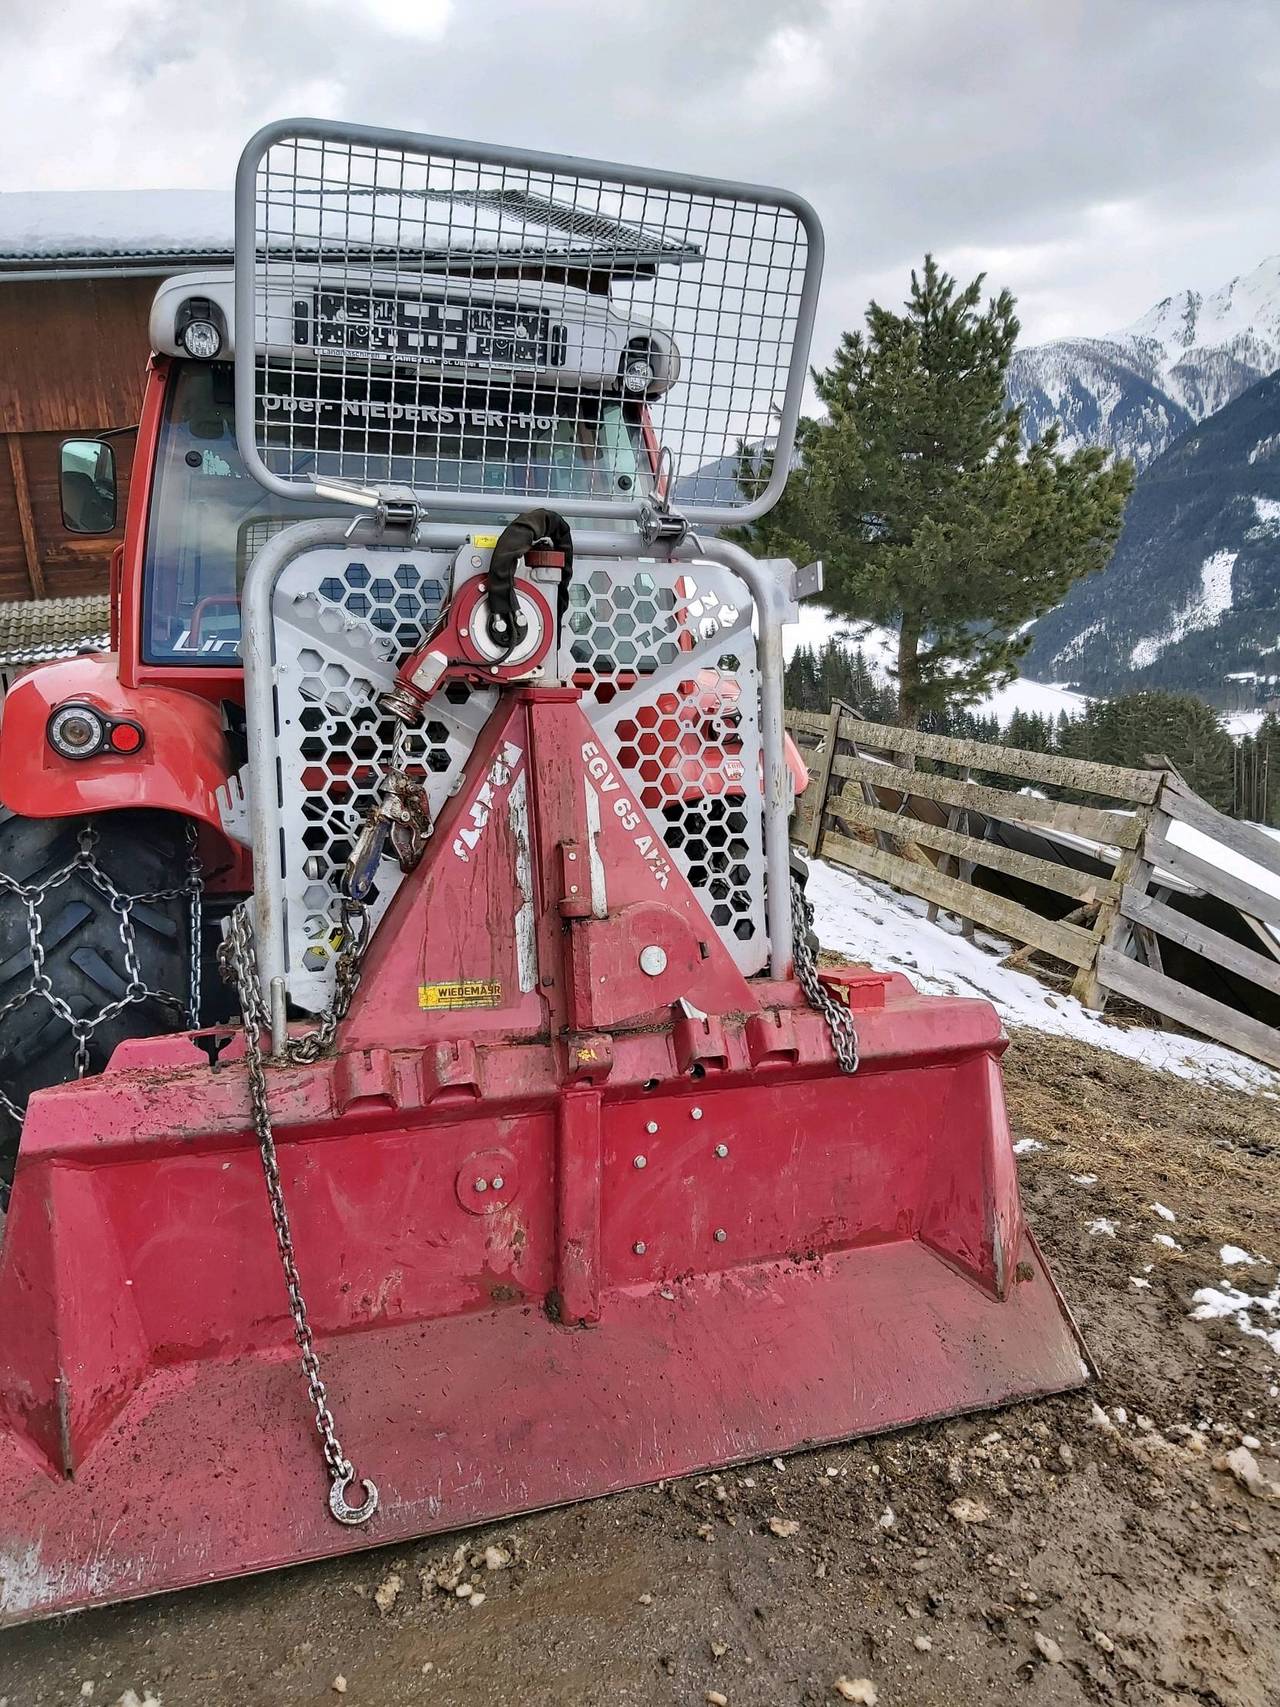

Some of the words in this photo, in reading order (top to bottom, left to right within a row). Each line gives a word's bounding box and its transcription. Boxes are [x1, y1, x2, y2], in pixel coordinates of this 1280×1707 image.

[262, 392, 333, 414] Ober-
[342, 398, 504, 427] NIEDERSTER
[635, 589, 720, 649] TAJFUN
[580, 740, 621, 793] EGV
[613, 797, 641, 831] 65
[438, 984, 501, 997] WIEDEMAYR
